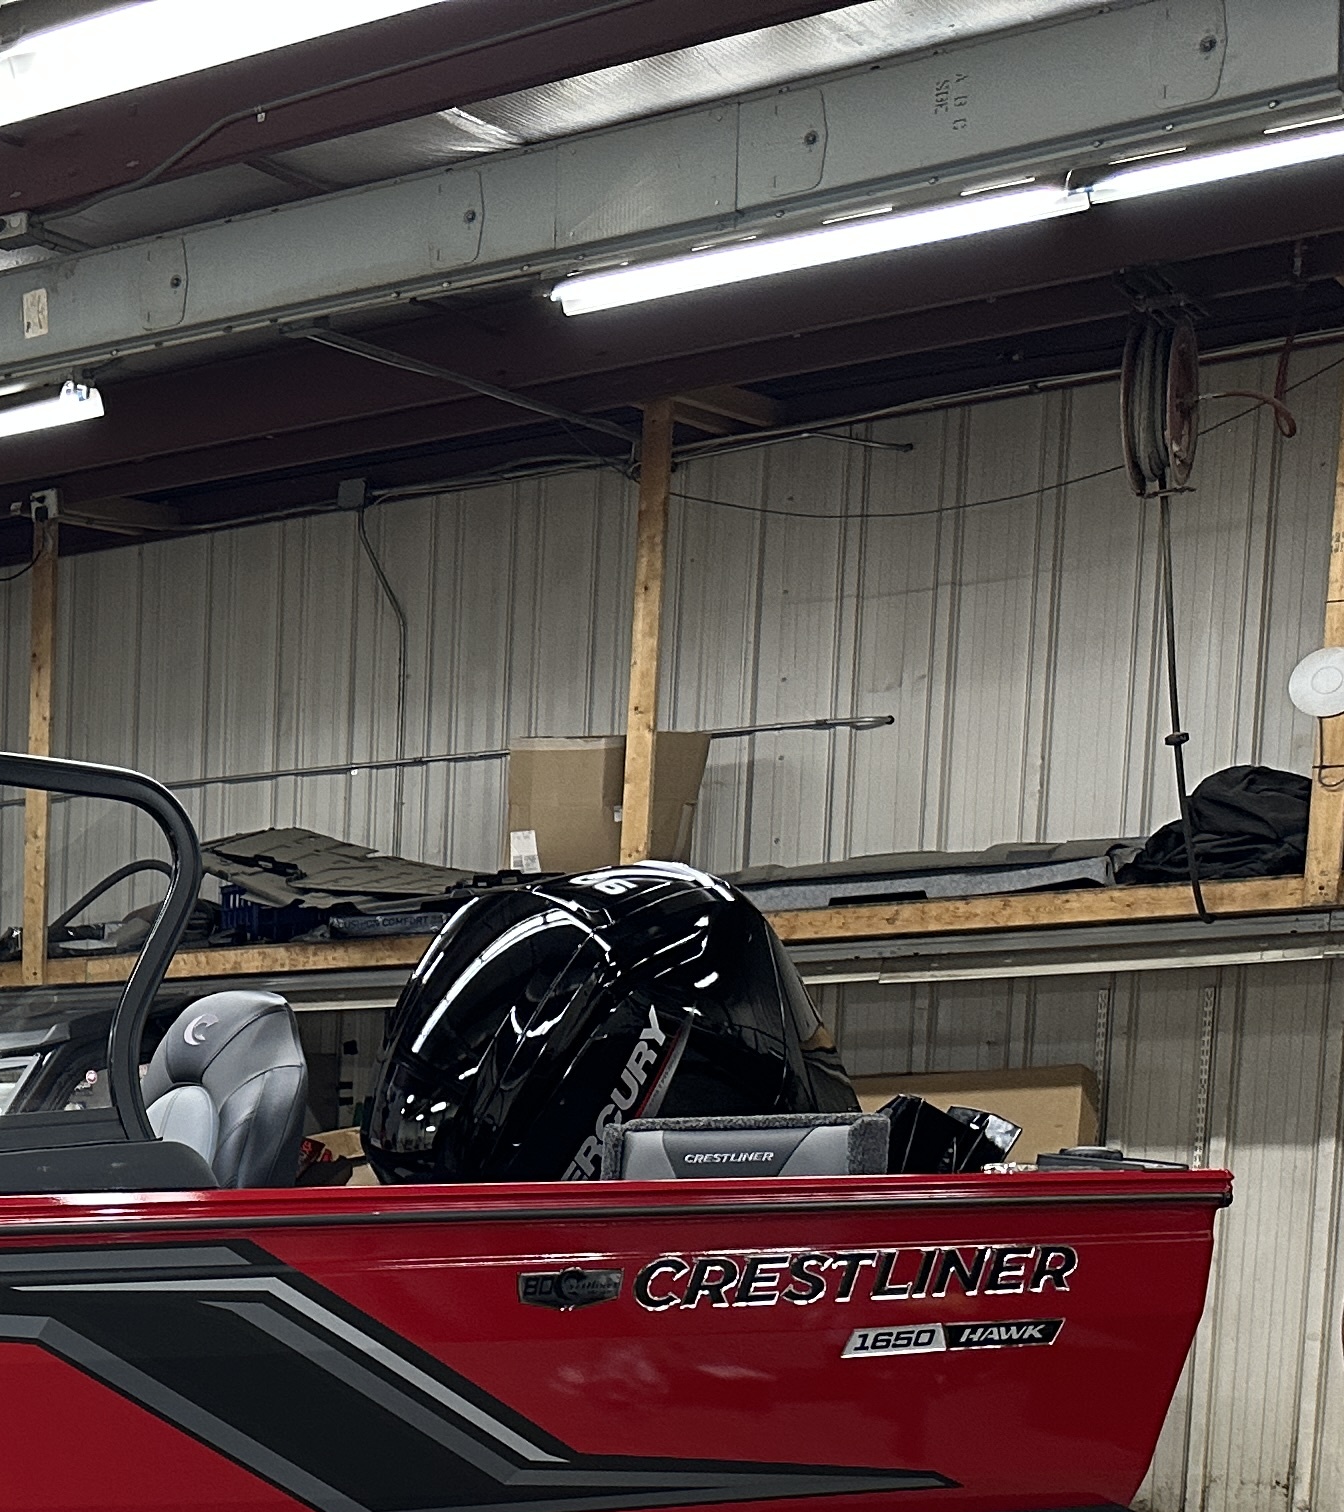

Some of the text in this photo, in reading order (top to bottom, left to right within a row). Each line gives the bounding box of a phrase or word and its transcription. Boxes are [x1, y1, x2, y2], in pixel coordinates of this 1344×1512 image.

[382, 915, 429, 928] COMFORT
[561, 1004, 667, 1181] ERCURY
[684, 1151, 774, 1164] CRESTLINER
[634, 1244, 1078, 1312] CRESTLINER
[853, 1324, 1046, 1351] 1650 HAWK
